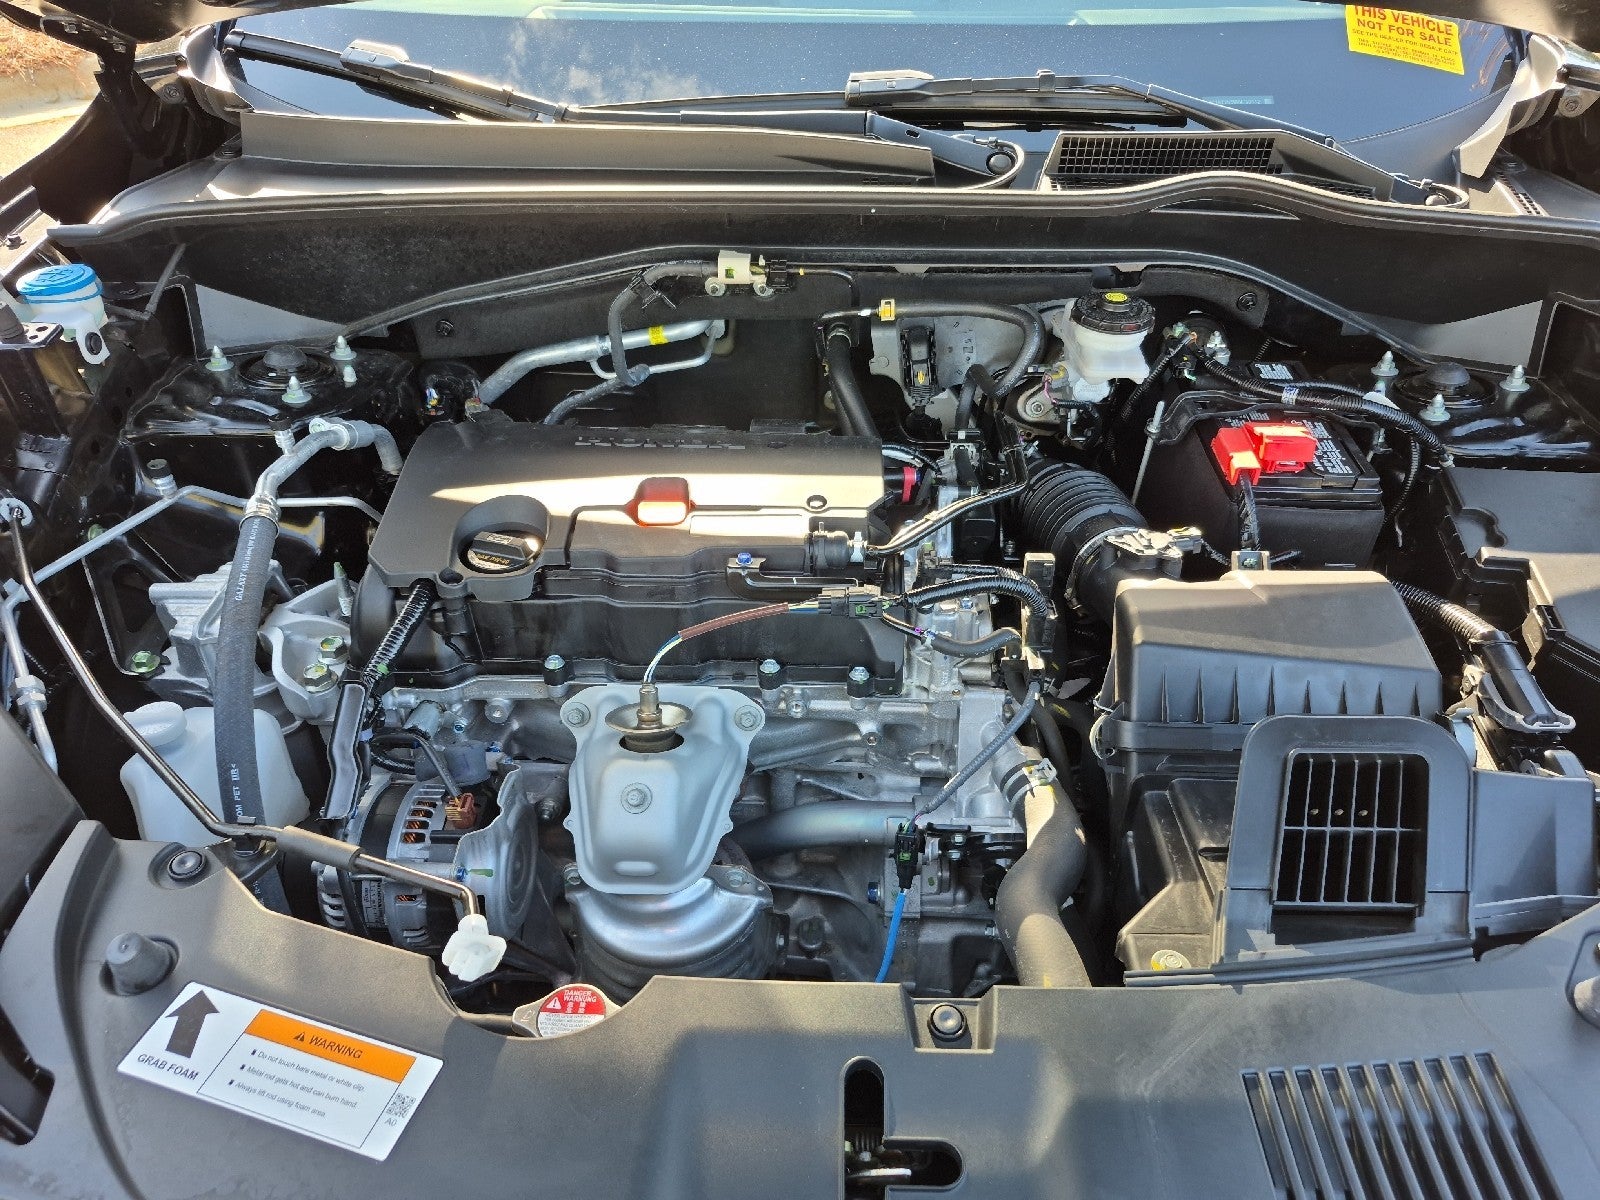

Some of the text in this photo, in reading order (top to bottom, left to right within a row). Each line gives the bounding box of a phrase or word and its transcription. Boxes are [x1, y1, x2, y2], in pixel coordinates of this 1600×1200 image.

[1354, 6, 1453, 36] THIS VEHICLE
[1357, 19, 1452, 46] NOT FOR SALE
[235, 573, 248, 601] GALAXY
[564, 995, 597, 1003] WARNING
[309, 1035, 363, 1059] WARNING
[137, 1053, 199, 1081] GRAB FOAM
[257, 1051, 266, 1059] Do
[267, 1055, 279, 1063] not
[279, 1058, 295, 1068] touch
[295, 1063, 310, 1074] bare
[310, 1068, 328, 1080] metal
[336, 1077, 352, 1088] white
[235, 1082, 257, 1095] Always
[257, 1088, 265, 1096] lift
[266, 1092, 277, 1101] rod
[277, 1096, 294, 1108] using
[294, 1101, 311, 1111] foam
[247, 1066, 264, 1077] Metal
[264, 1071, 276, 1081] rod
[275, 1075, 288, 1086] gets
[289, 1080, 300, 1089] hot
[300, 1083, 313, 1093] and
[313, 1089, 325, 1098] can
[325, 1092, 340, 1103] burn
